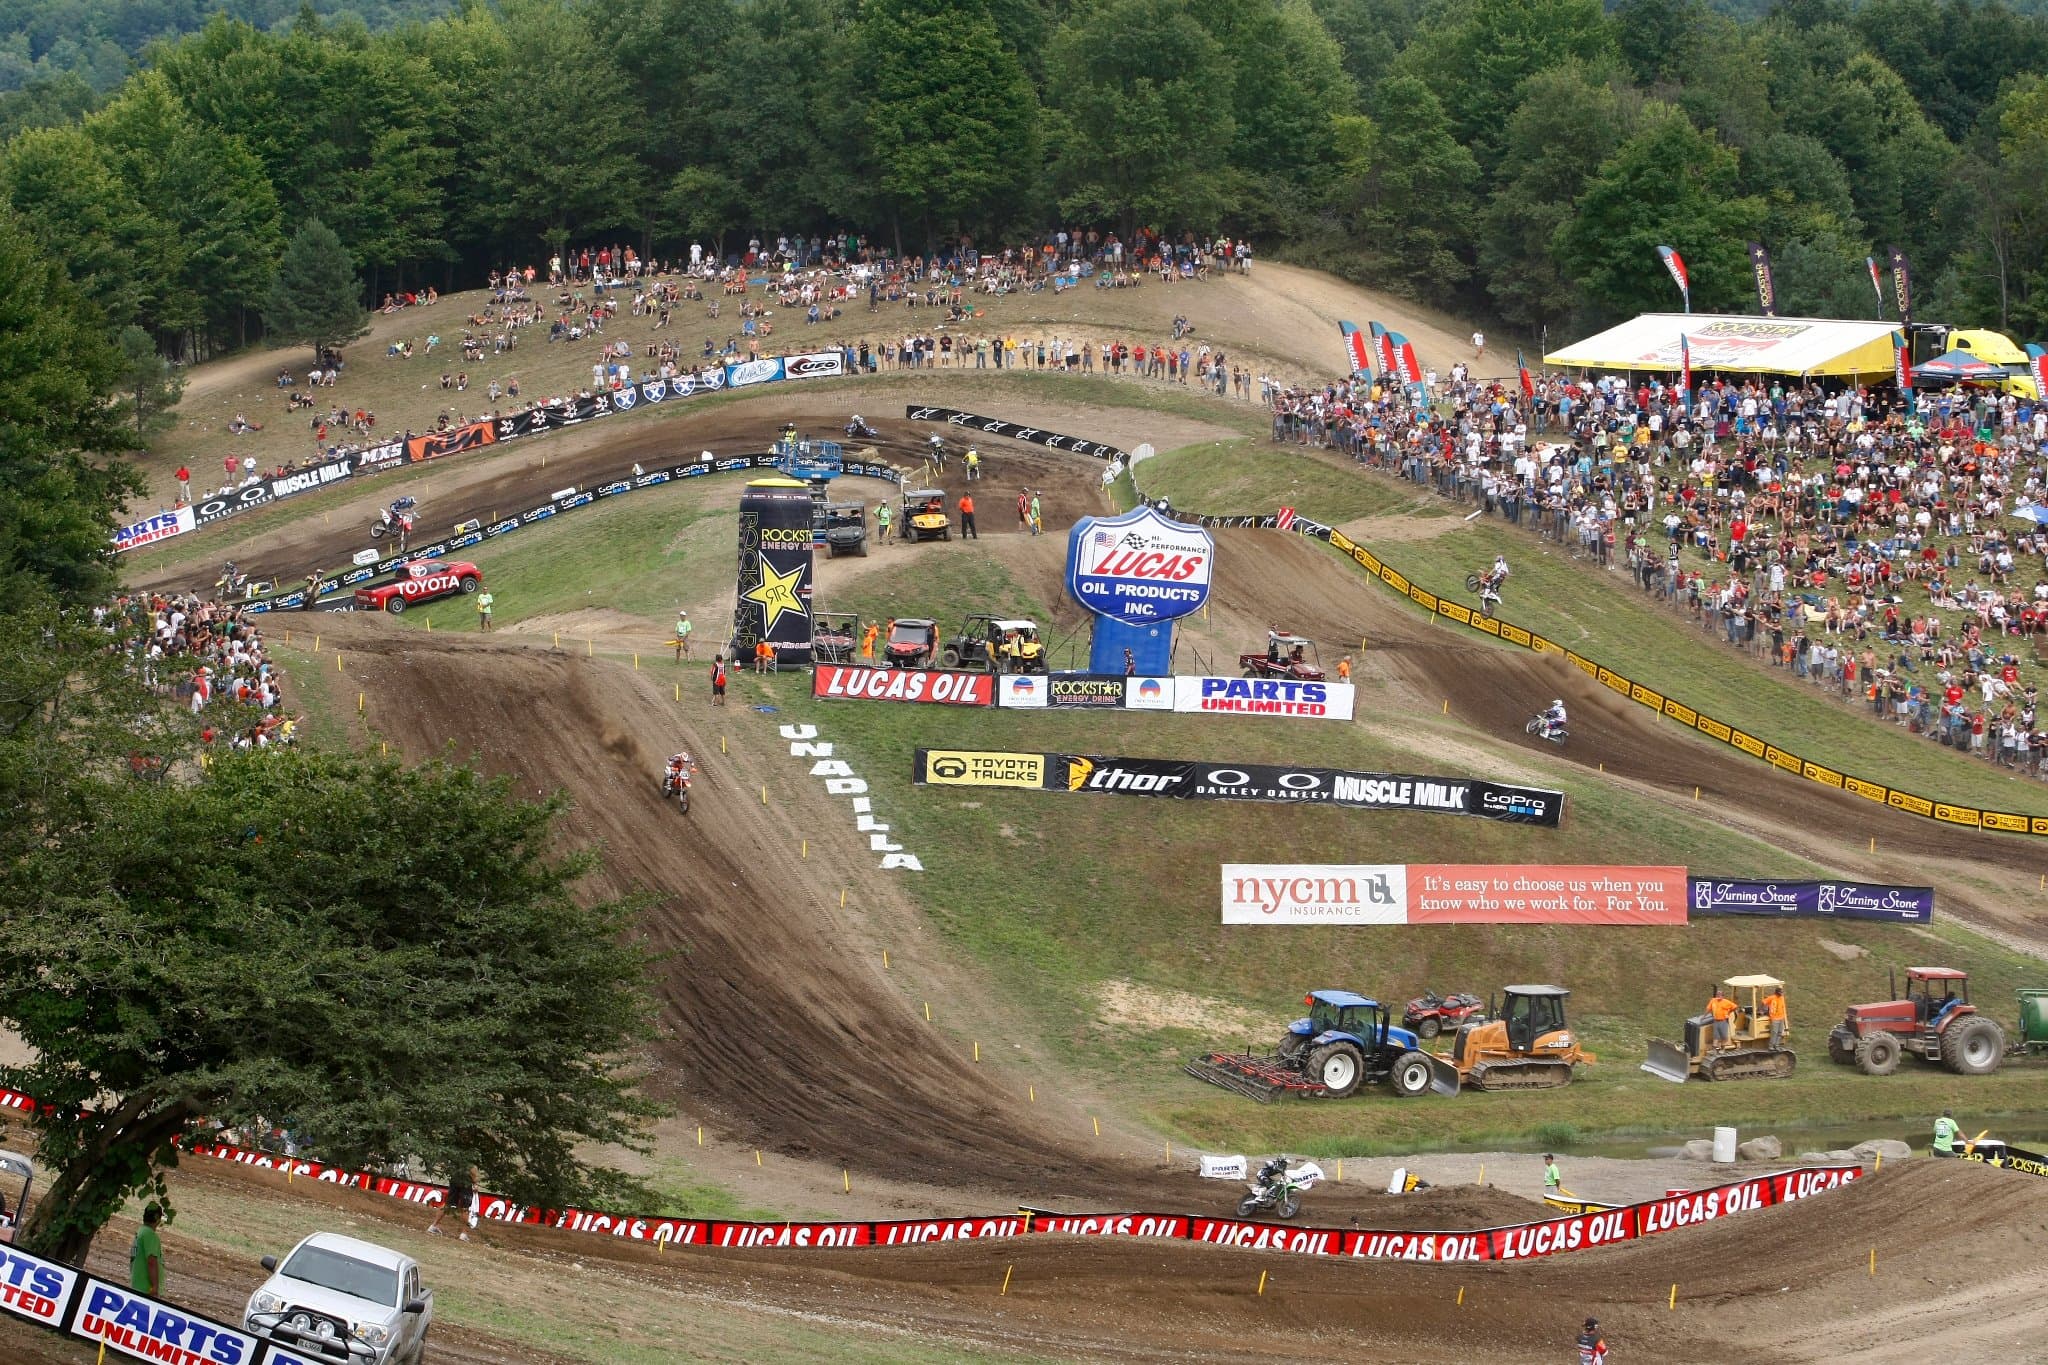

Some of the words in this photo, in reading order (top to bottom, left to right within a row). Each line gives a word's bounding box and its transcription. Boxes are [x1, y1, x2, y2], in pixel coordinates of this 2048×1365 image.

[636, 470, 669, 484] GoPro
[676, 464, 709, 474] GoPro
[272, 470, 319, 496] MUSCLE
[320, 460, 350, 484] MILK
[598, 481, 630, 494] GoPro
[236, 494, 274, 512] OAKLEY
[561, 492, 593, 506] GoPro
[196, 508, 234, 526] OAKLEY
[524, 504, 556, 520] GoPro
[112, 512, 178, 542] ARTS
[488, 518, 518, 534] GoPro
[114, 525, 180, 550] NLIMITED
[450, 530, 482, 546] GoPro
[762, 542, 799, 550] ENERGY
[414, 544, 444, 558] GoPro
[1151, 544, 1206, 554] PERFORMANCE
[378, 556, 408, 570] GoPro
[1092, 550, 1203, 580] LUCAS
[344, 568, 373, 581] GoPro
[394, 576, 460, 595] TOYOTA
[1082, 582, 1110, 595] OIL
[1115, 584, 1200, 602] PRODUCTS
[242, 600, 271, 610] GoPro
[276, 592, 304, 604] GoPro
[1124, 602, 1158, 616] INC.
[828, 668, 926, 700] LUCAS
[932, 674, 978, 702] OIL
[1052, 680, 1122, 696] ROCKSTAR
[1202, 678, 1326, 702] PARTS
[1201, 698, 1326, 716] UNLIMITED
[972, 758, 1038, 770] TOYOTA
[971, 769, 1038, 782] TRUCKS
[1090, 768, 1183, 791] thor
[779, 724, 924, 870] UNADILLA
[1196, 785, 1258, 796] OAKLEY
[1268, 788, 1330, 800] OAKLEY
[1333, 776, 1410, 805] MUSCLE
[1414, 782, 1464, 809] MILK
[1483, 792, 1545, 808] GoPro
[1232, 876, 1360, 914] nycm
[1424, 876, 1450, 891] It's
[1455, 880, 1487, 894] easy
[1493, 878, 1508, 891] to
[1514, 876, 1564, 891] choose
[1568, 881, 1586, 892] us
[1592, 878, 1630, 893] when
[1636, 882, 1664, 898] you
[1714, 884, 1758, 904] Turning
[1760, 885, 1796, 903] Stone
[1420, 896, 1462, 910] know
[1467, 896, 1500, 910] who
[1505, 899, 1526, 910] we
[1530, 896, 1568, 910] work
[1573, 896, 1597, 910] for.
[1607, 896, 1632, 911] For
[1638, 897, 1668, 912] You.
[1836, 888, 1879, 909] Turning
[1882, 890, 1918, 909] Stone
[1290, 906, 1360, 916] INSURANCE
[1293, 1172, 1318, 1182] ARTS
[1783, 1170, 1854, 1202] LUCAS
[1646, 1193, 1719, 1234] LUCAS
[1726, 1184, 1762, 1214] OIL
[1201, 1222, 1286, 1250] LUCAS
[1289, 1233, 1330, 1255] OIL
[1502, 1218, 1582, 1260] LUCAS
[1589, 1212, 1626, 1243] OIL
[1352, 1234, 1434, 1260] LUCAS
[1440, 1237, 1480, 1261] OIL
[88, 1287, 244, 1365] PARTS
